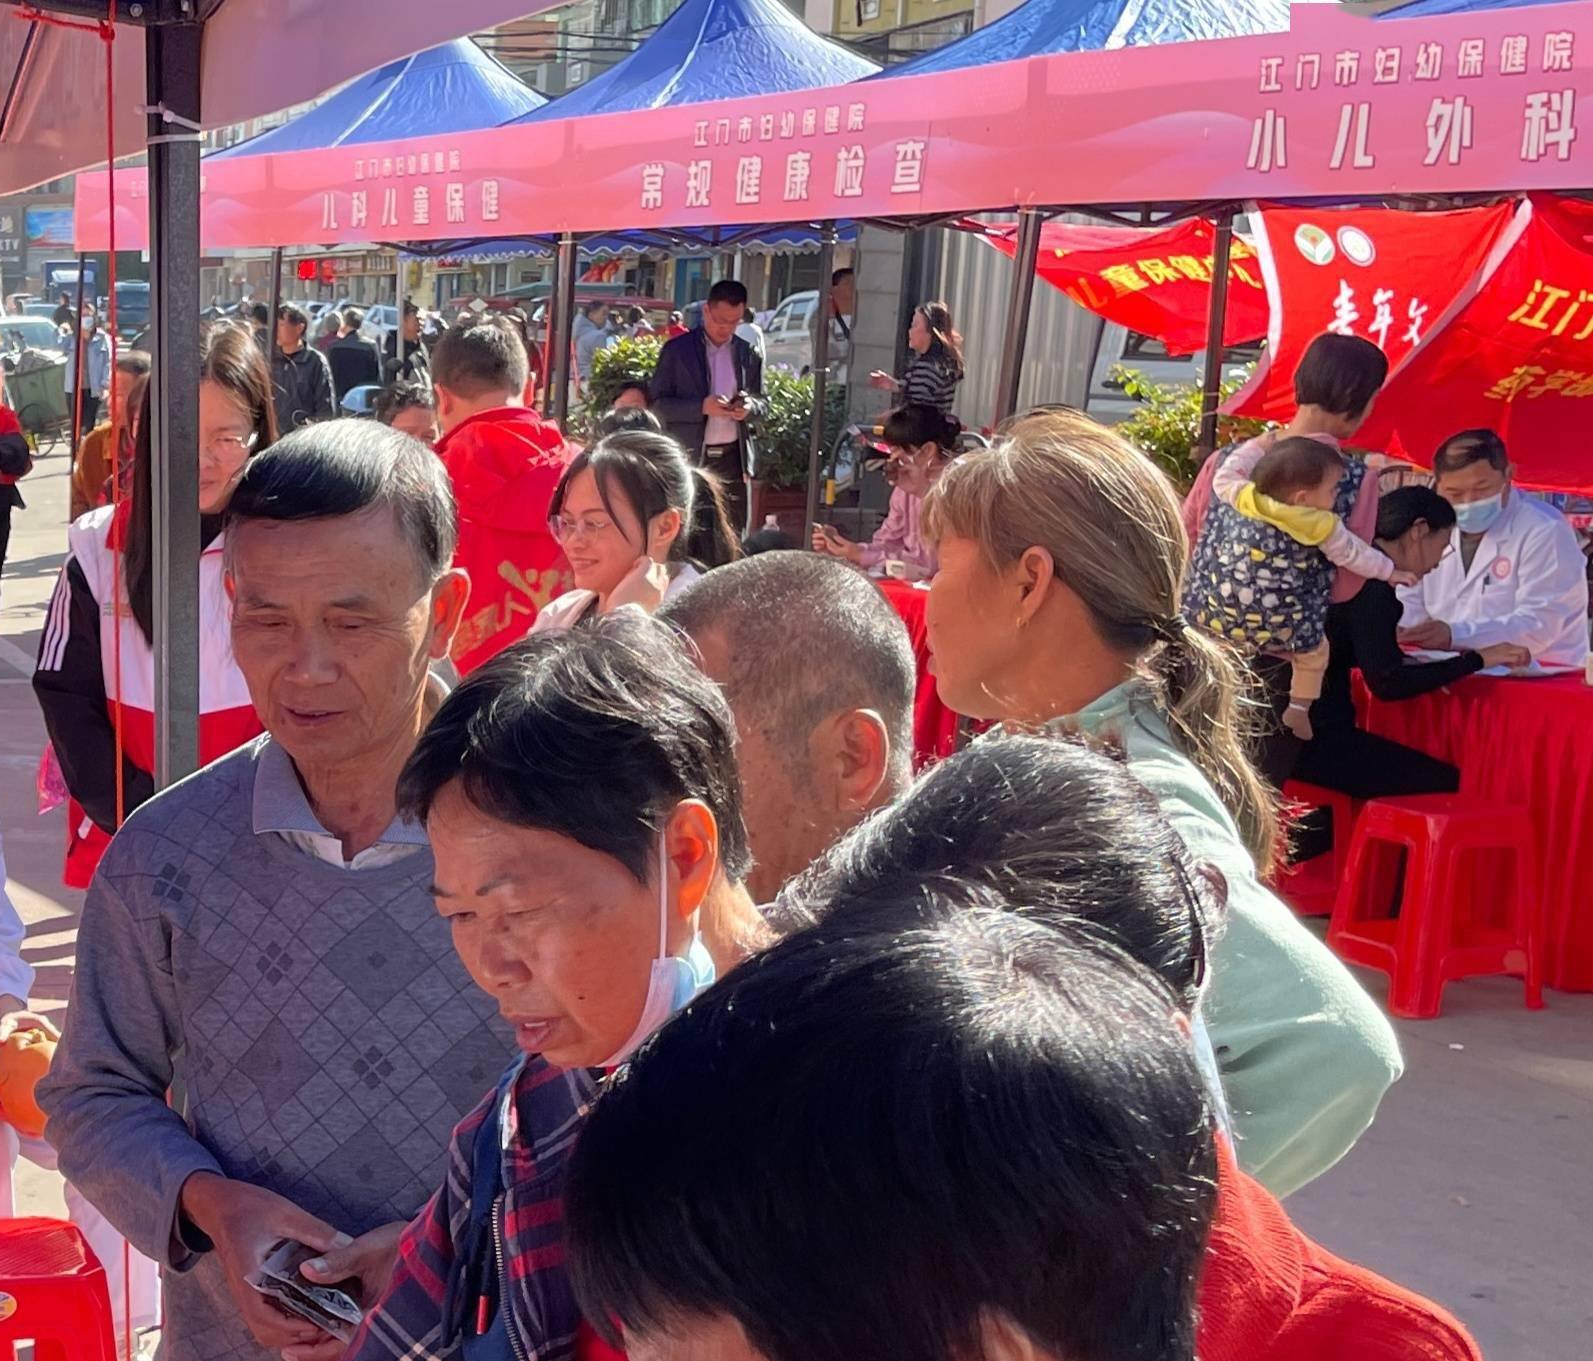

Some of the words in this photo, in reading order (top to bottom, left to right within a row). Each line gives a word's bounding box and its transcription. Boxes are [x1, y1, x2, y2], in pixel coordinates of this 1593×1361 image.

[1259, 31, 1575, 92] 江门市妇幼保健院
[694, 102, 866, 147] 江门市妇幼保健院
[1246, 89, 1577, 173] 小儿外科
[322, 180, 499, 230] 儿科儿童保健
[640, 140, 926, 210] 常规健康检查
